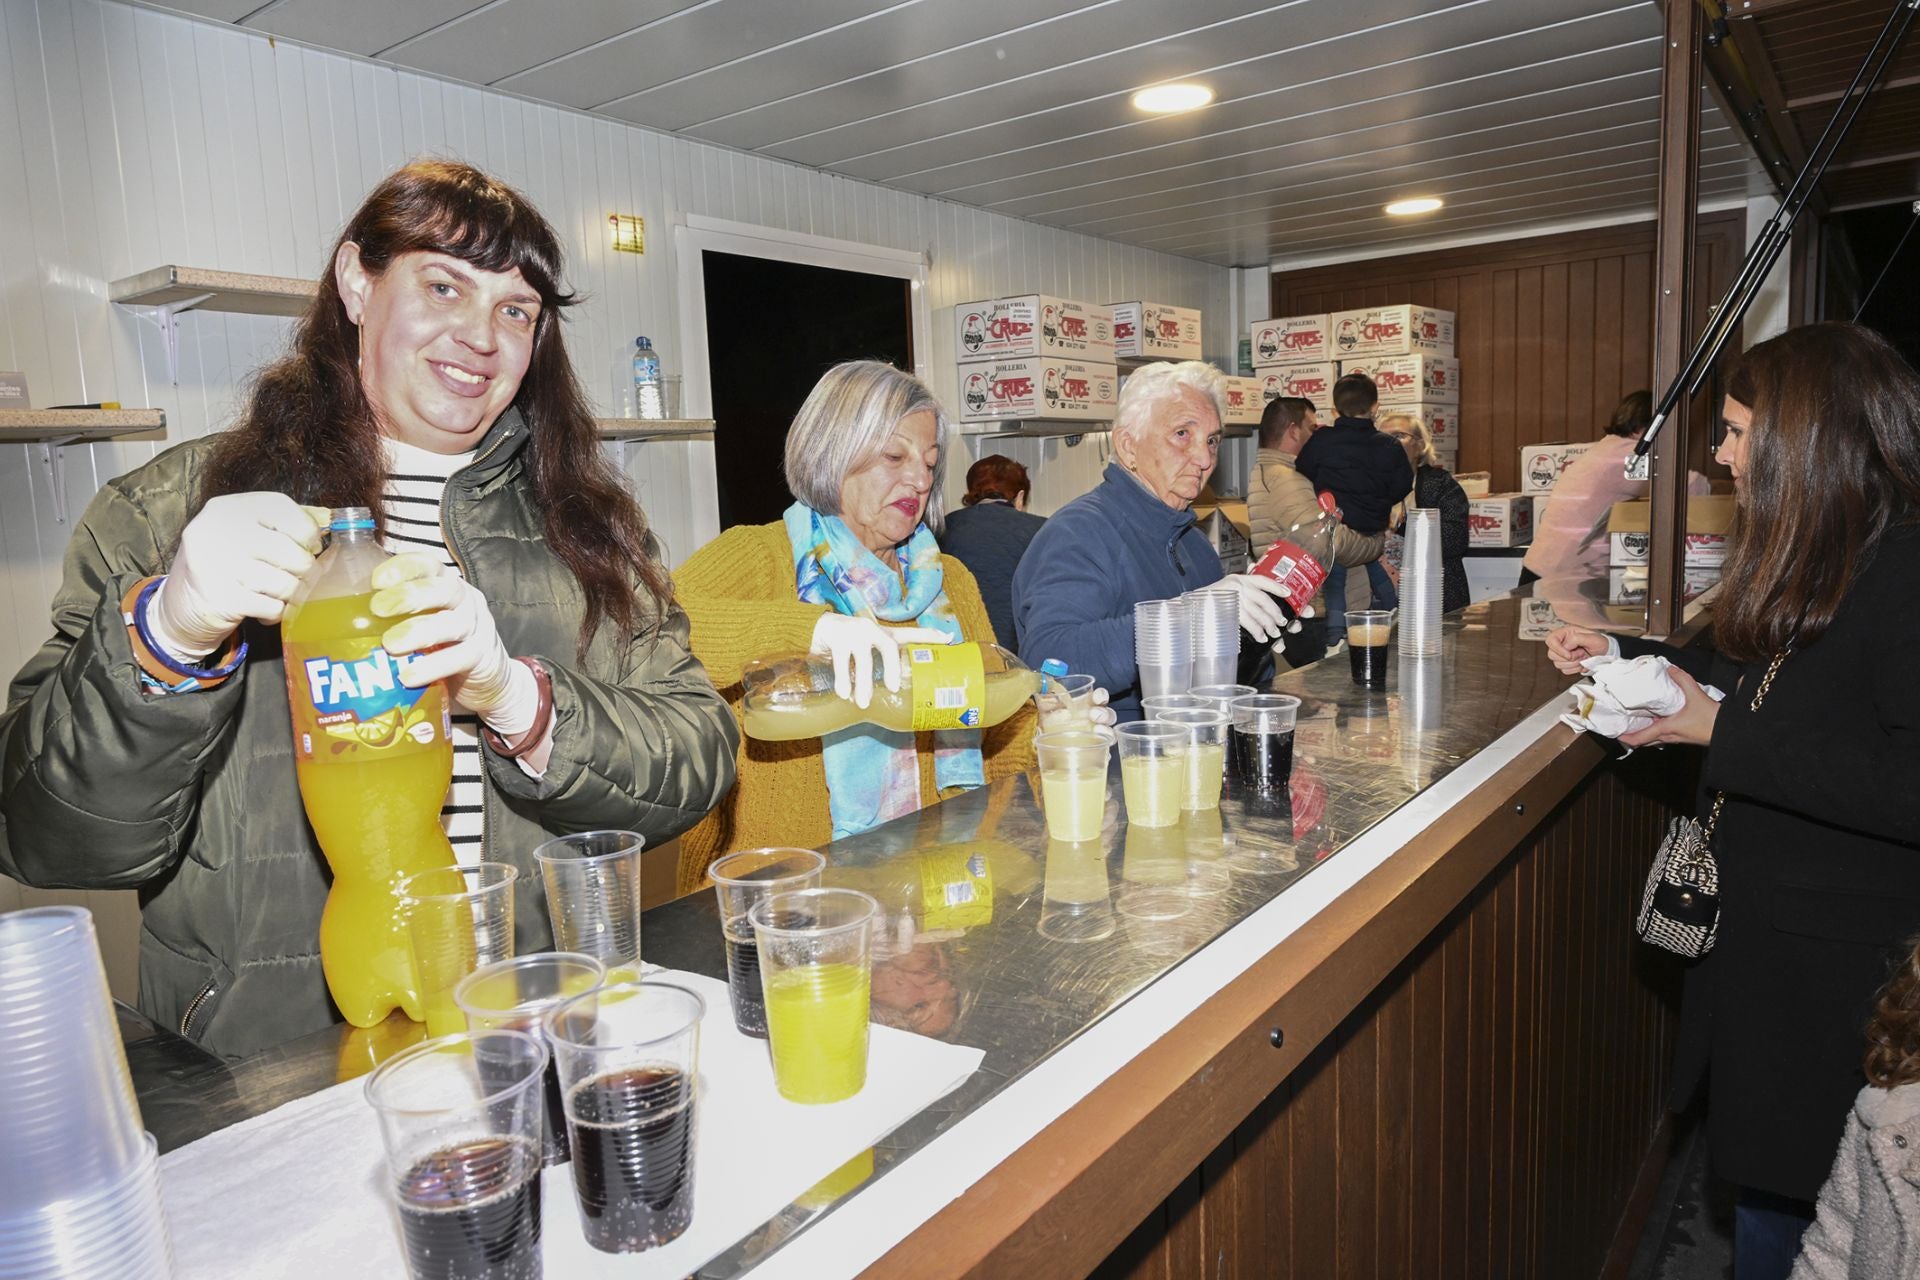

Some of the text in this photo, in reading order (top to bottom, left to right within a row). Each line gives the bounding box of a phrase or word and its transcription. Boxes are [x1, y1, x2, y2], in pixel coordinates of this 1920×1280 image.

[990, 317, 1032, 342] CRUCE
[1061, 316, 1087, 342] CRUCE
[1362, 322, 1402, 343] CRUCE
[1283, 330, 1322, 351] CRUCE
[995, 363, 1027, 371] BOLLERIA
[991, 376, 1034, 403] CRUCE
[1063, 378, 1090, 402] CRUCE
[1287, 378, 1326, 398] CRUCE
[1375, 370, 1414, 391] CRUCE
[1468, 514, 1501, 535] RUCE
[318, 712, 353, 724] naranja
